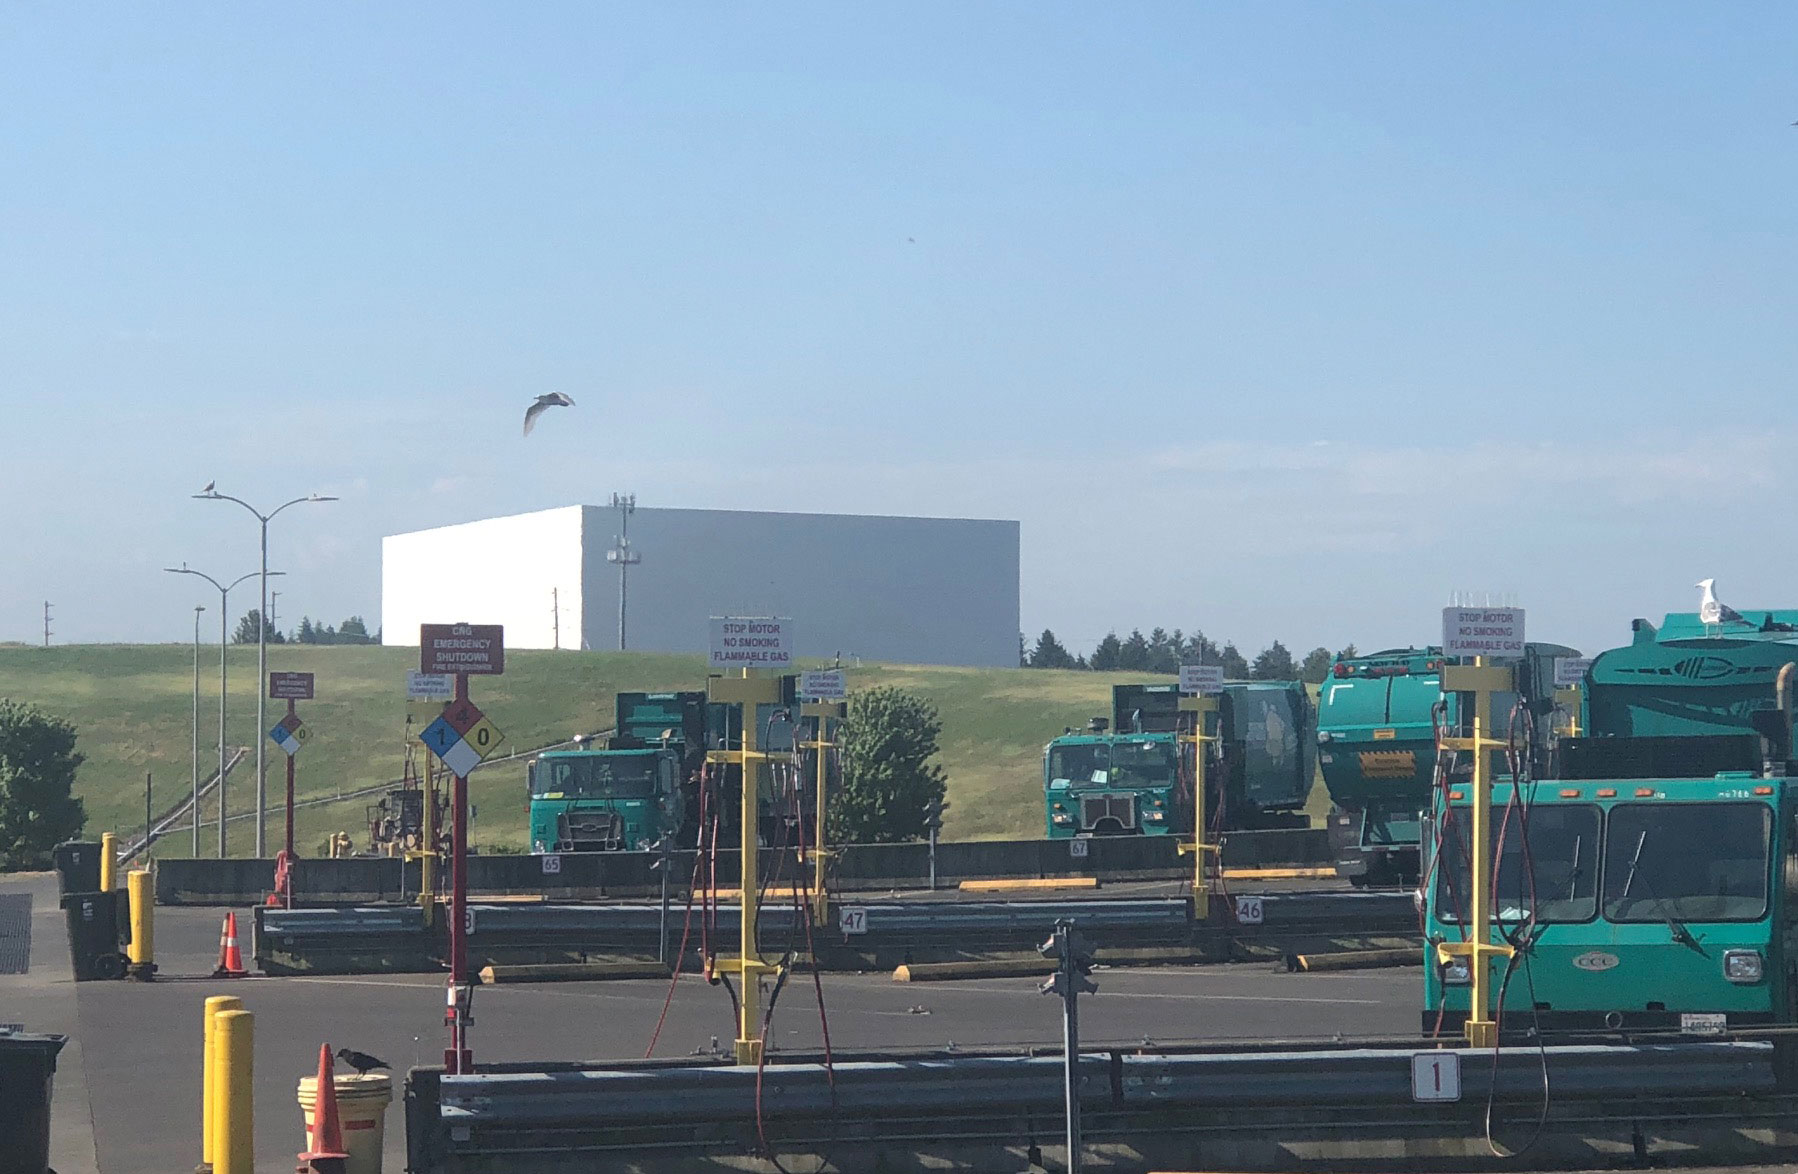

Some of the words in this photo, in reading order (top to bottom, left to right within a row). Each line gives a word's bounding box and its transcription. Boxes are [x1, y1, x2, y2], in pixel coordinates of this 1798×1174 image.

[1459, 613, 1481, 622] STOP
[1482, 613, 1514, 623] MOTOR
[452, 626, 472, 635] CNG
[723, 624, 747, 633] STOP
[748, 624, 780, 634] MOTOR
[1459, 627, 1472, 636] NO
[1473, 627, 1513, 637] SMOKING
[433, 638, 492, 649] EMERGENCY
[723, 637, 737, 647] NO
[738, 637, 780, 648] SMOKING
[1450, 640, 1502, 650] FLAMMABLE
[1503, 641, 1523, 650] GAS
[436, 652, 489, 662] SHUTDOWN
[714, 651, 769, 661] FLAMMABLE
[770, 652, 790, 661] GAS
[437, 728, 446, 746] 1
[477, 727, 490, 746] 0
[1072, 842, 1085, 855] 67
[545, 858, 559, 870] 65
[1239, 902, 1260, 919] 46
[844, 912, 864, 930] 47
[1432, 1061, 1441, 1092] 1
